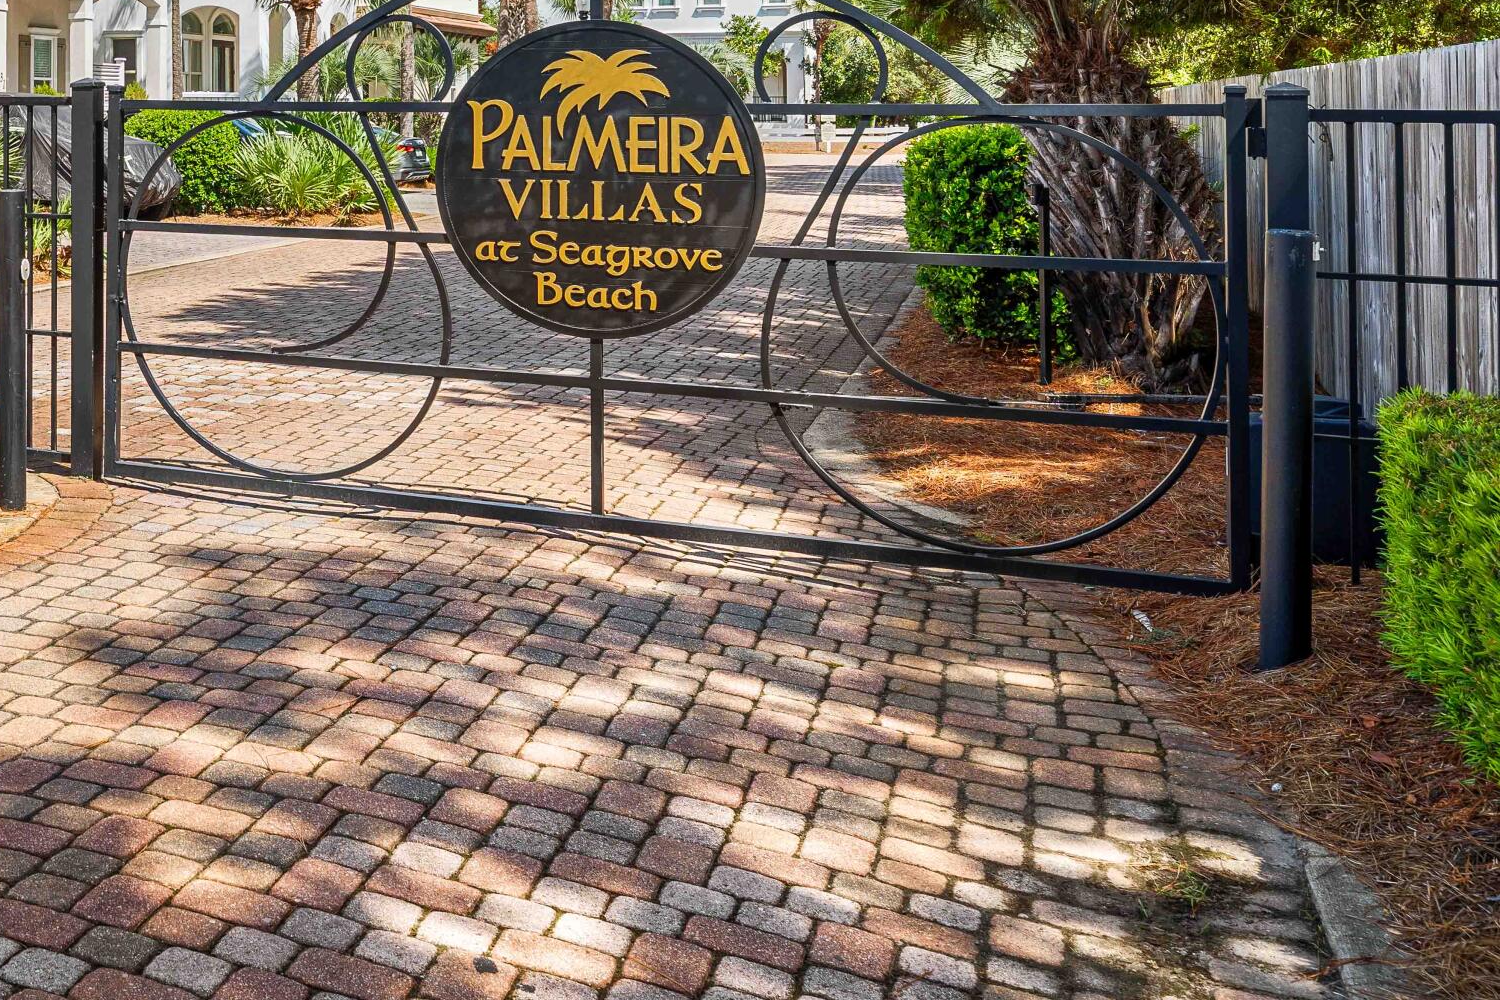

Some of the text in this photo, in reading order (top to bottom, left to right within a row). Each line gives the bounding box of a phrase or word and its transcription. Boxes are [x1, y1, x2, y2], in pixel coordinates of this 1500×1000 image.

[467, 99, 750, 175] PALMEIRA
[498, 178, 703, 224] VILLAS
[475, 230, 723, 277] at Seagrove
[532, 271, 658, 311] Beach
